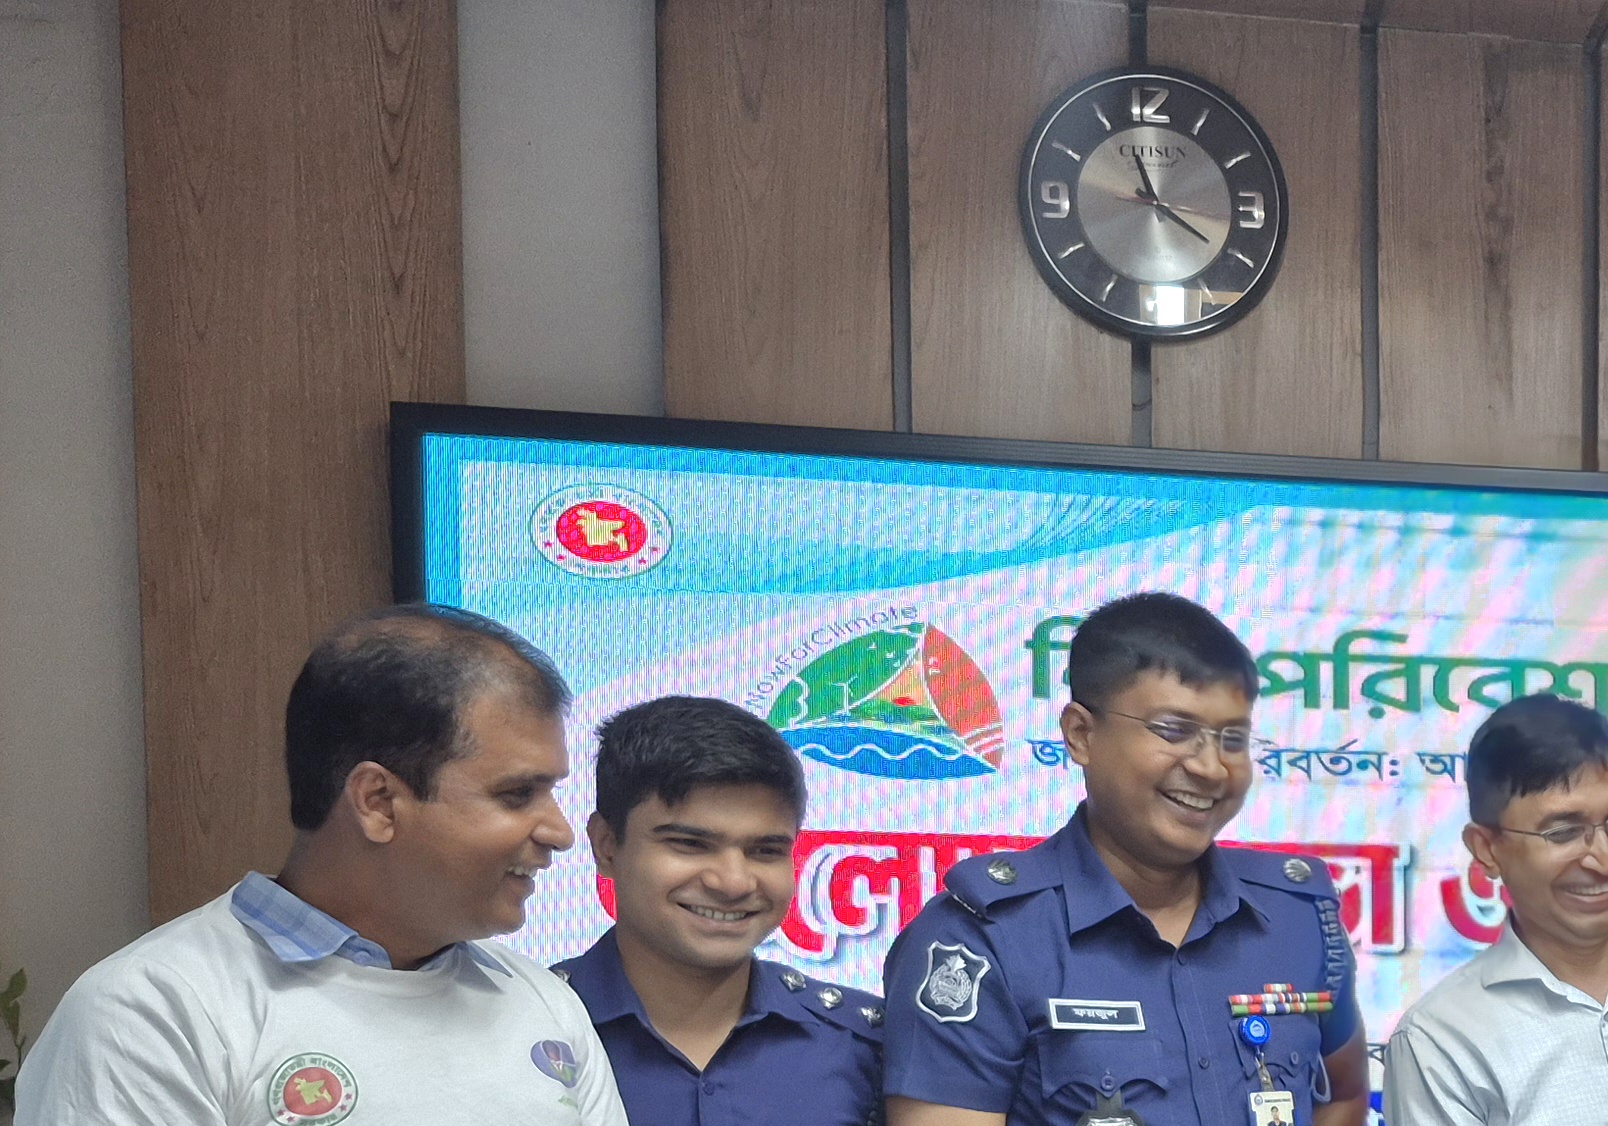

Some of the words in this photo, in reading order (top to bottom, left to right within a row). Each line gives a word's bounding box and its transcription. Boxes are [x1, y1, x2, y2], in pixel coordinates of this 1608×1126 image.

[1130, 86, 1171, 123] 12
[1041, 180, 1070, 219] 9
[1238, 191, 1265, 229] 3
